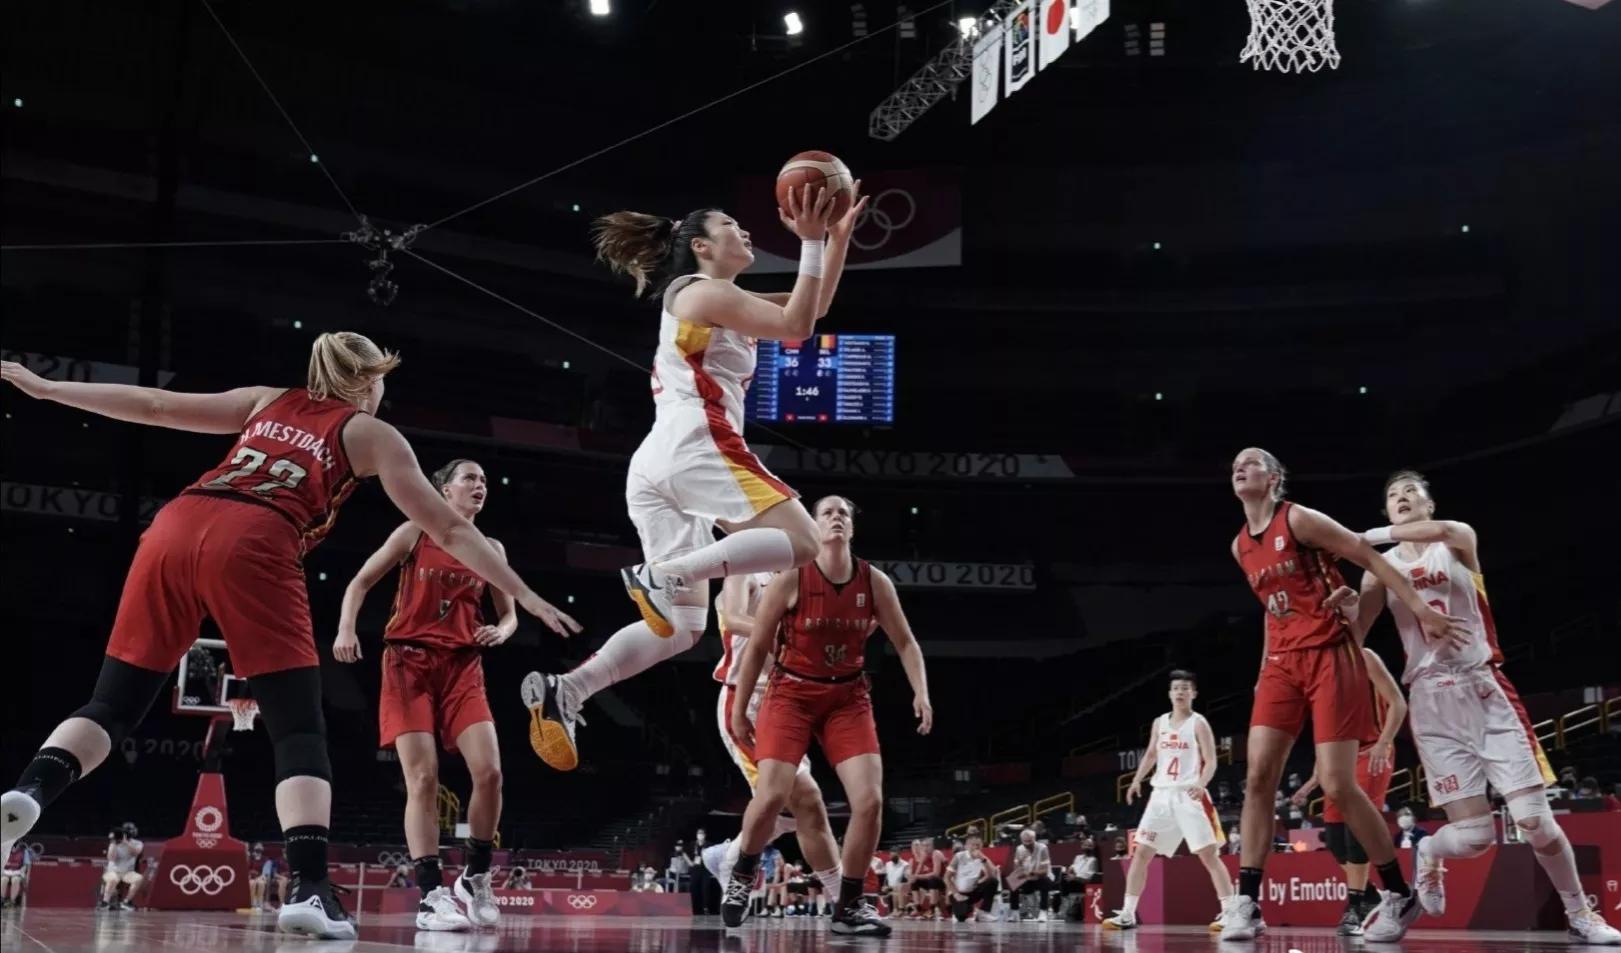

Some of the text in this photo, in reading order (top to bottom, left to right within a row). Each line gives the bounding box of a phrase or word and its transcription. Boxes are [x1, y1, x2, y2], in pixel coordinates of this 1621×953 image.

[784, 357, 799, 368] 36
[817, 357, 832, 368] 33
[795, 386, 819, 396] 1:46
[795, 449, 1018, 477] TOKYO 2020
[203, 446, 307, 498] 22
[956, 564, 1036, 586] 2020
[1160, 741, 1190, 749] CHINA
[1166, 756, 1180, 781] 4
[527, 859, 599, 870] TOKYO 2020
[1269, 877, 1287, 905] by
[509, 896, 534, 906] 2020
